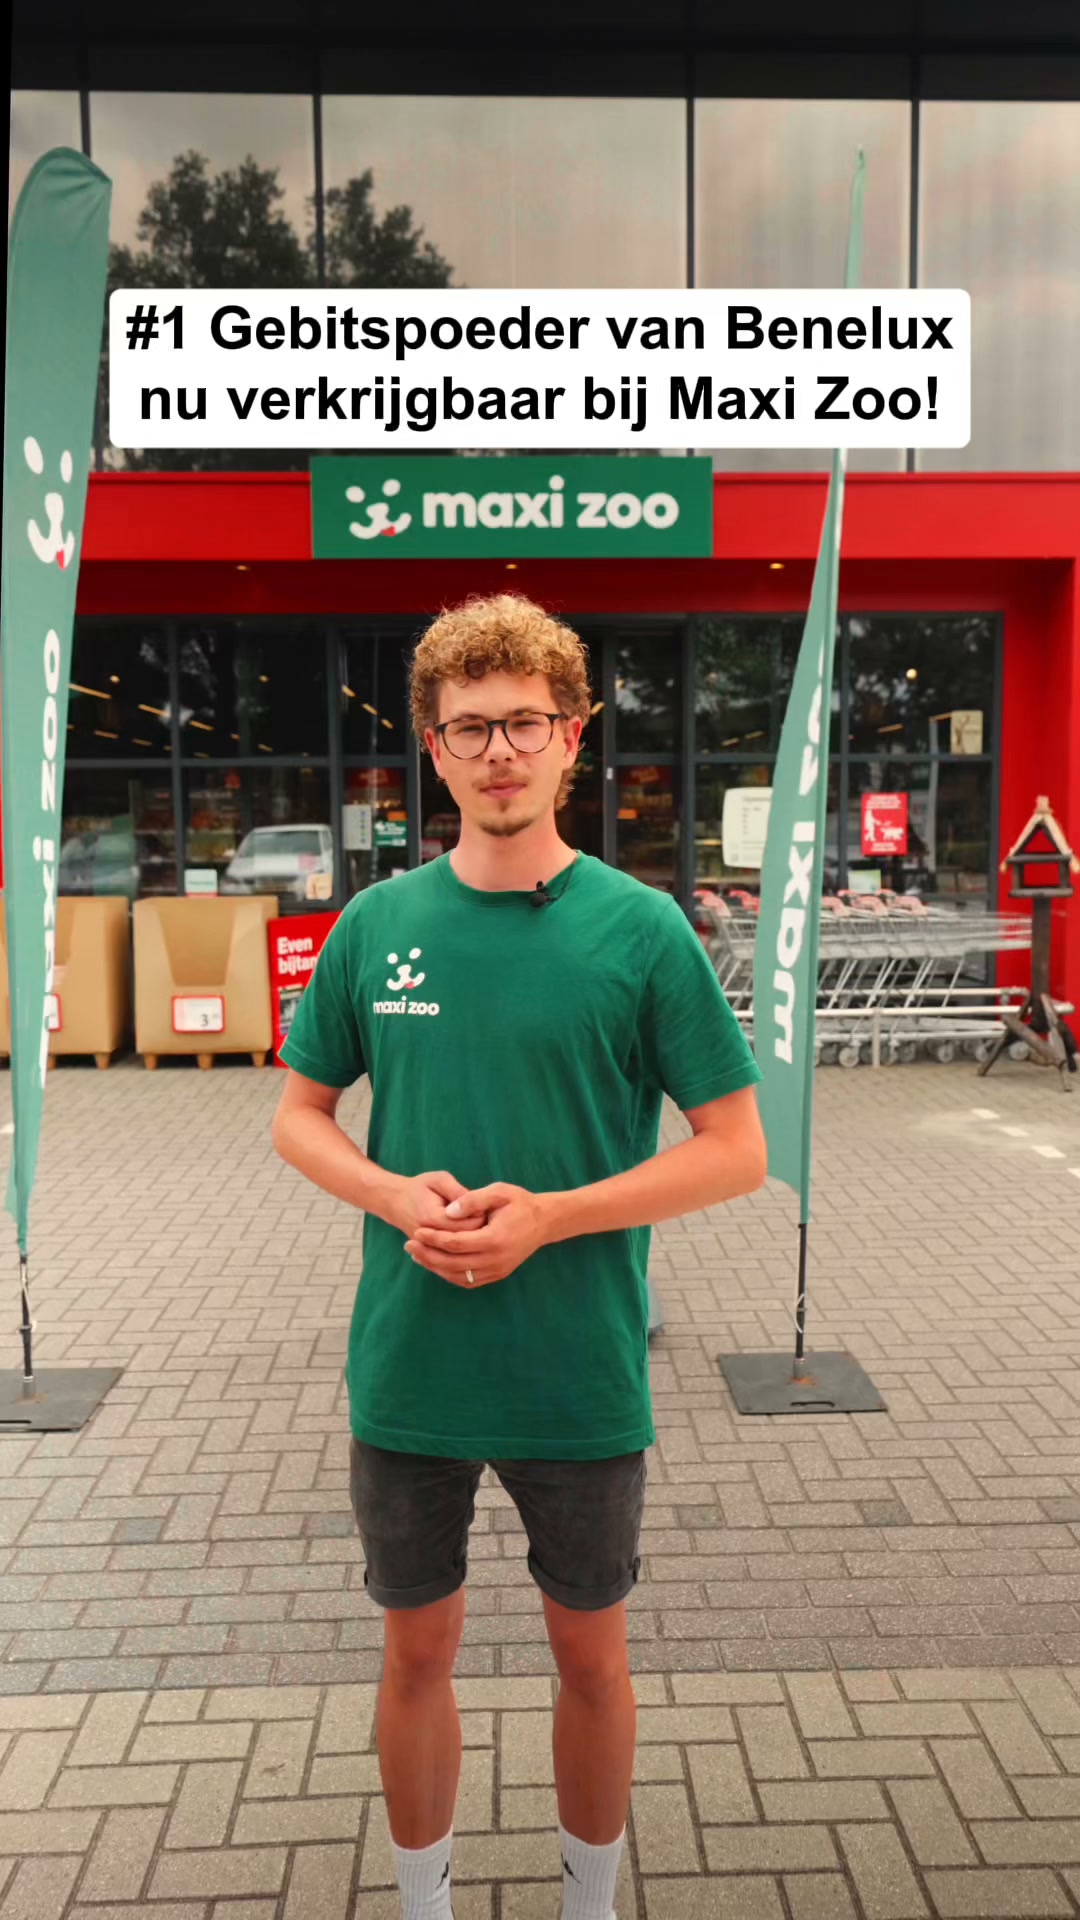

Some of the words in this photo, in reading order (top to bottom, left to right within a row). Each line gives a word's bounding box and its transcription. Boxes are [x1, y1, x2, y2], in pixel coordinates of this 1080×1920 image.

[423, 475, 564, 528] maxi
[577, 492, 680, 529] zoo
[41, 629, 60, 814] zoo
[277, 936, 314, 955] Even
[373, 995, 406, 1014] maxi
[407, 1001, 440, 1016] zoo
